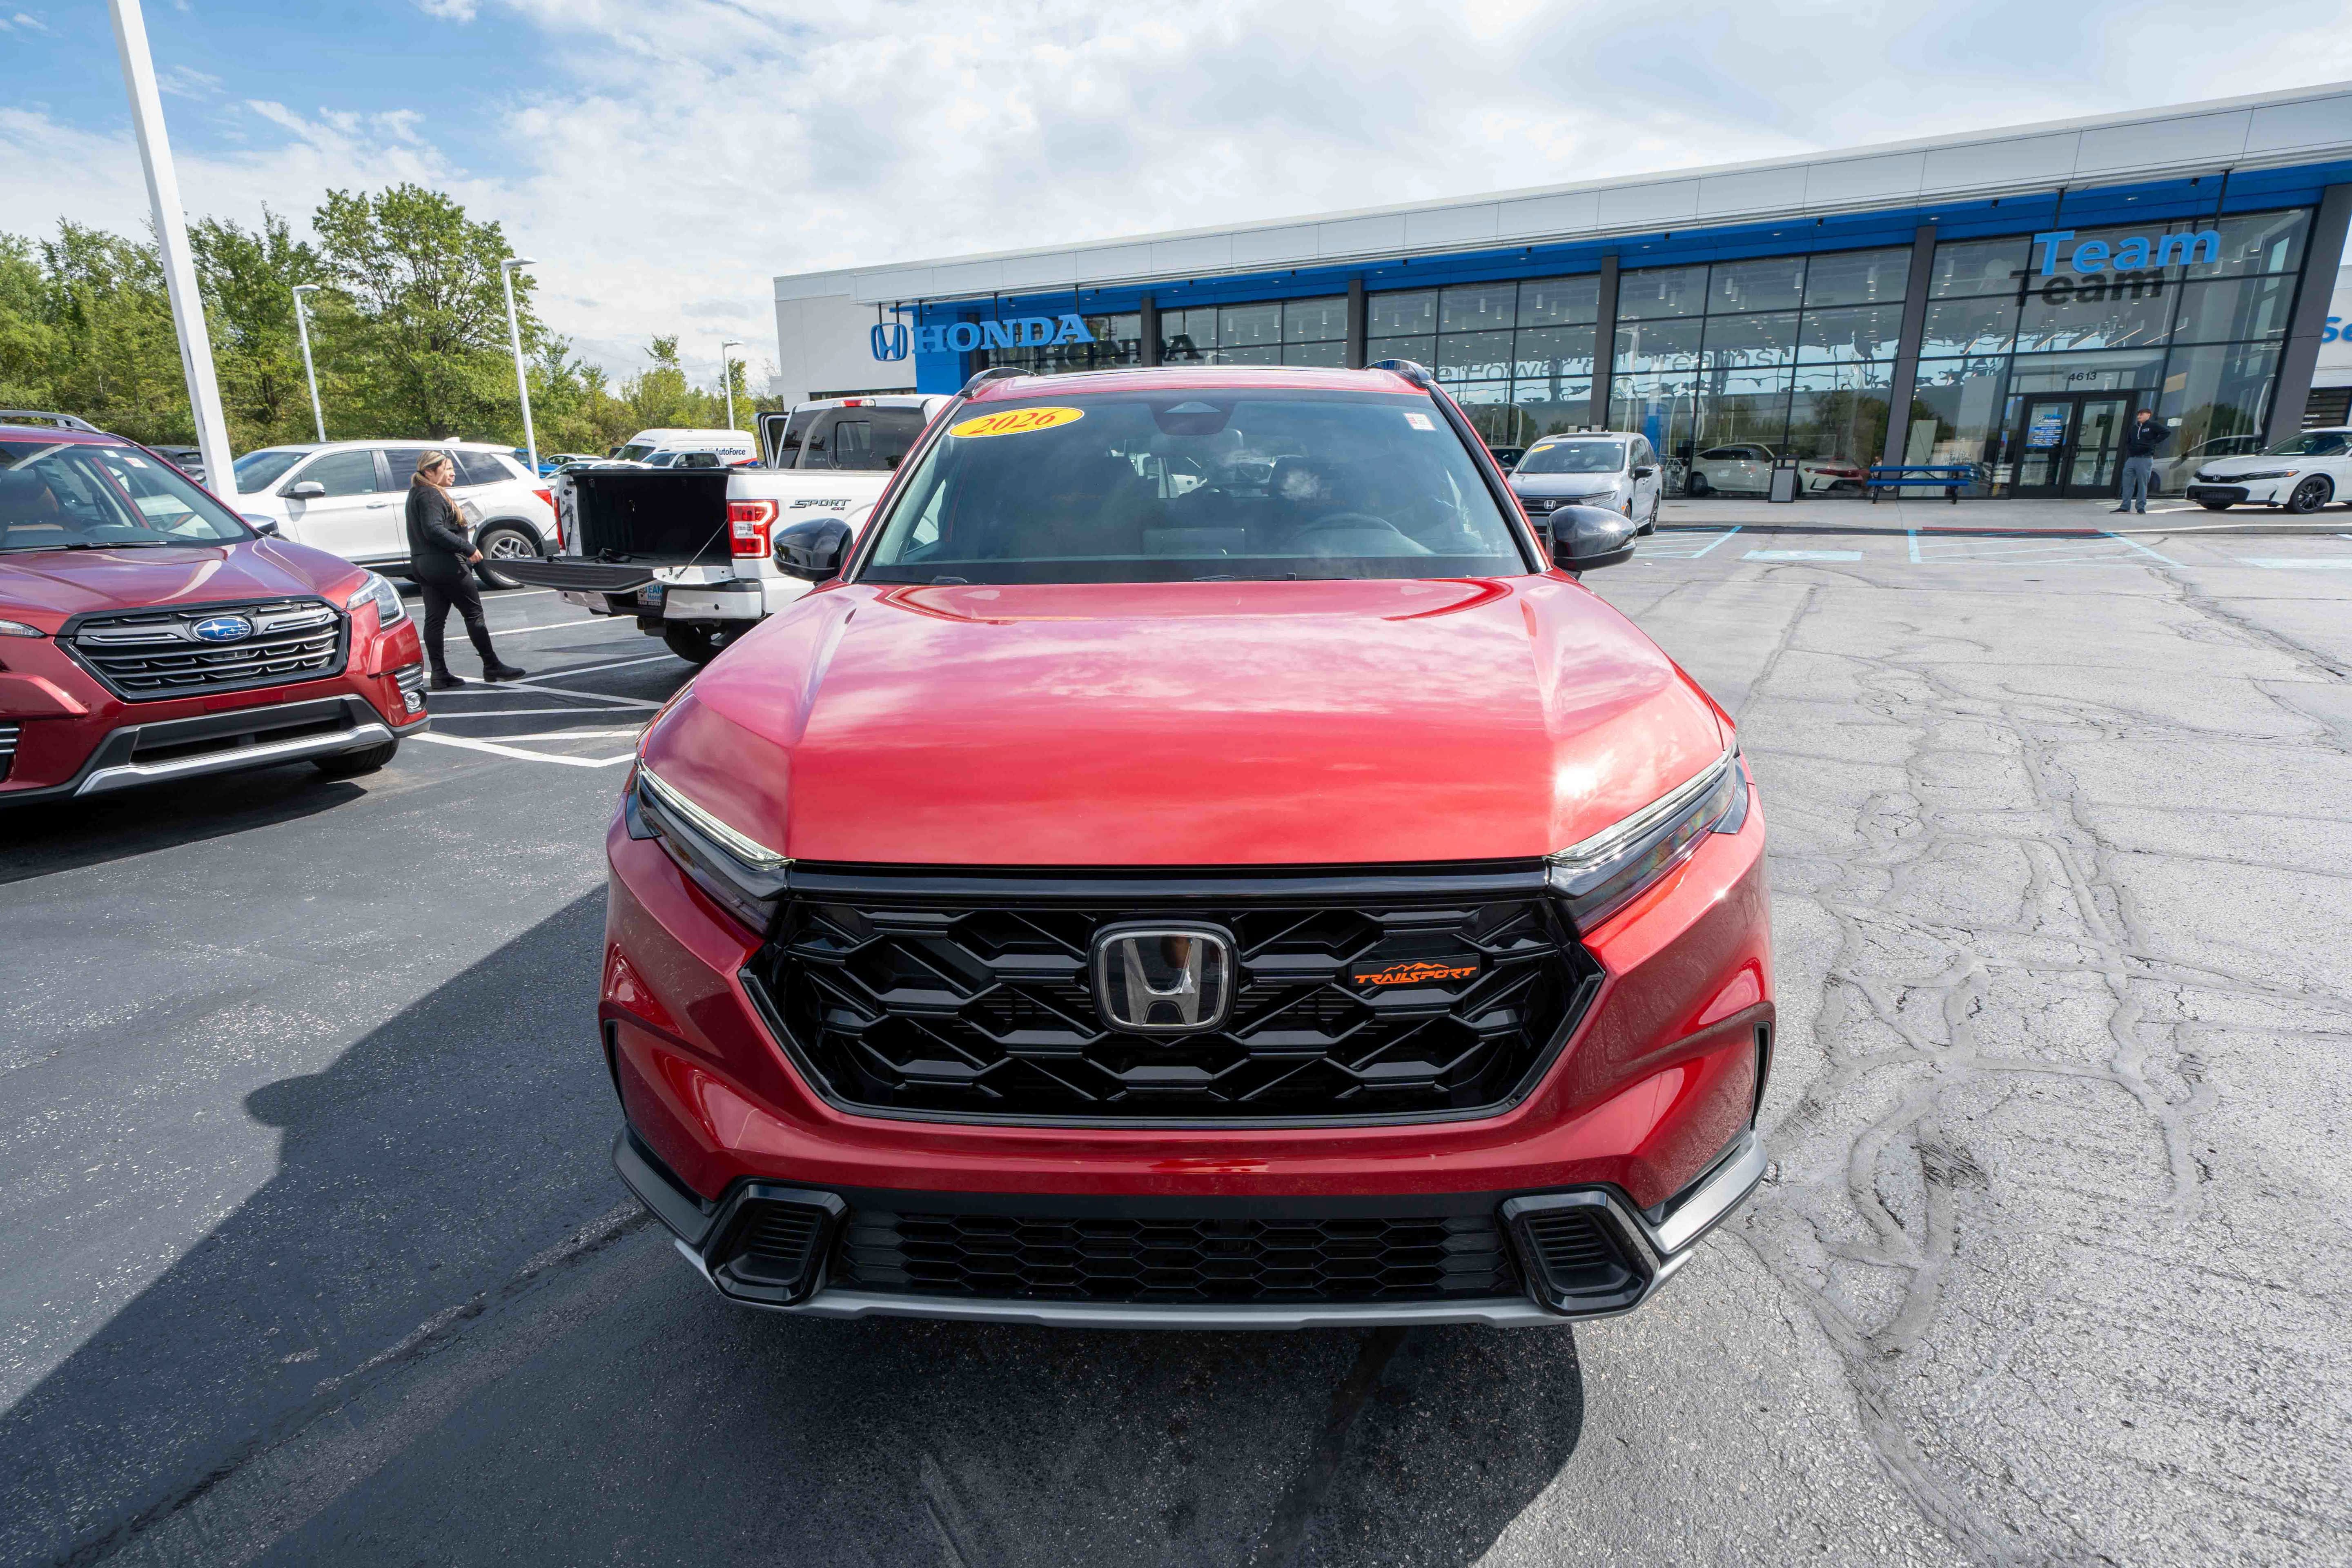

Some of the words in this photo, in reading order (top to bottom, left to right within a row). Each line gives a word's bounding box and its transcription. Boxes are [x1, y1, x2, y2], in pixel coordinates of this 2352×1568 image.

[2034, 230, 2221, 276] Team
[911, 314, 1097, 354] HONDA
[2068, 372, 2097, 381] 4613
[967, 410, 1062, 434] 2026
[789, 499, 852, 509] SPORT
[1354, 967, 1477, 984] TRAILSPORT
